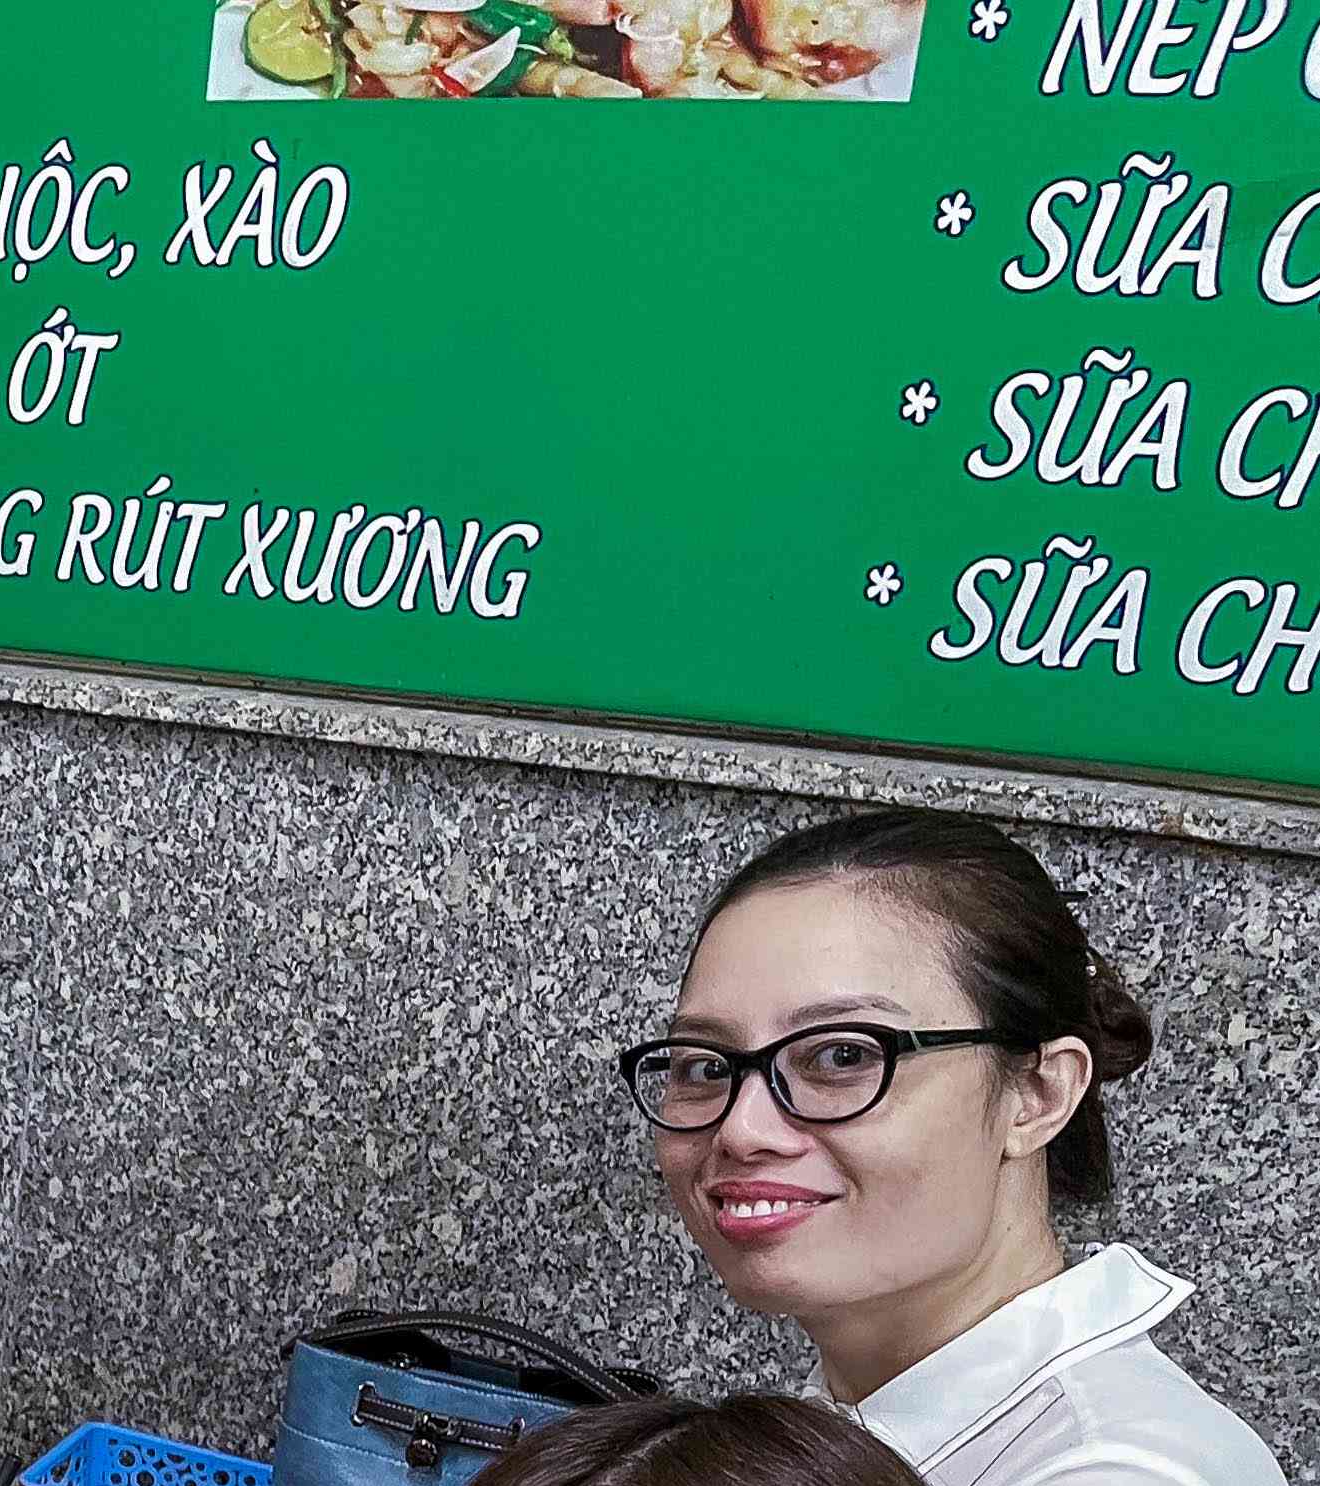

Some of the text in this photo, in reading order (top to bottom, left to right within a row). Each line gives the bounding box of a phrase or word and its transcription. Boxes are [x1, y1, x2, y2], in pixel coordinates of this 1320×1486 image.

[165, 139, 348, 269] XÀO
[1003, 153, 1230, 299] SỮA
[7, 307, 120, 425] ỚT
[966, 348, 1188, 490] SỮA
[56, 476, 226, 592] RÚT
[223, 503, 541, 618] XƯƠNG
[929, 535, 1148, 675] SỮA
